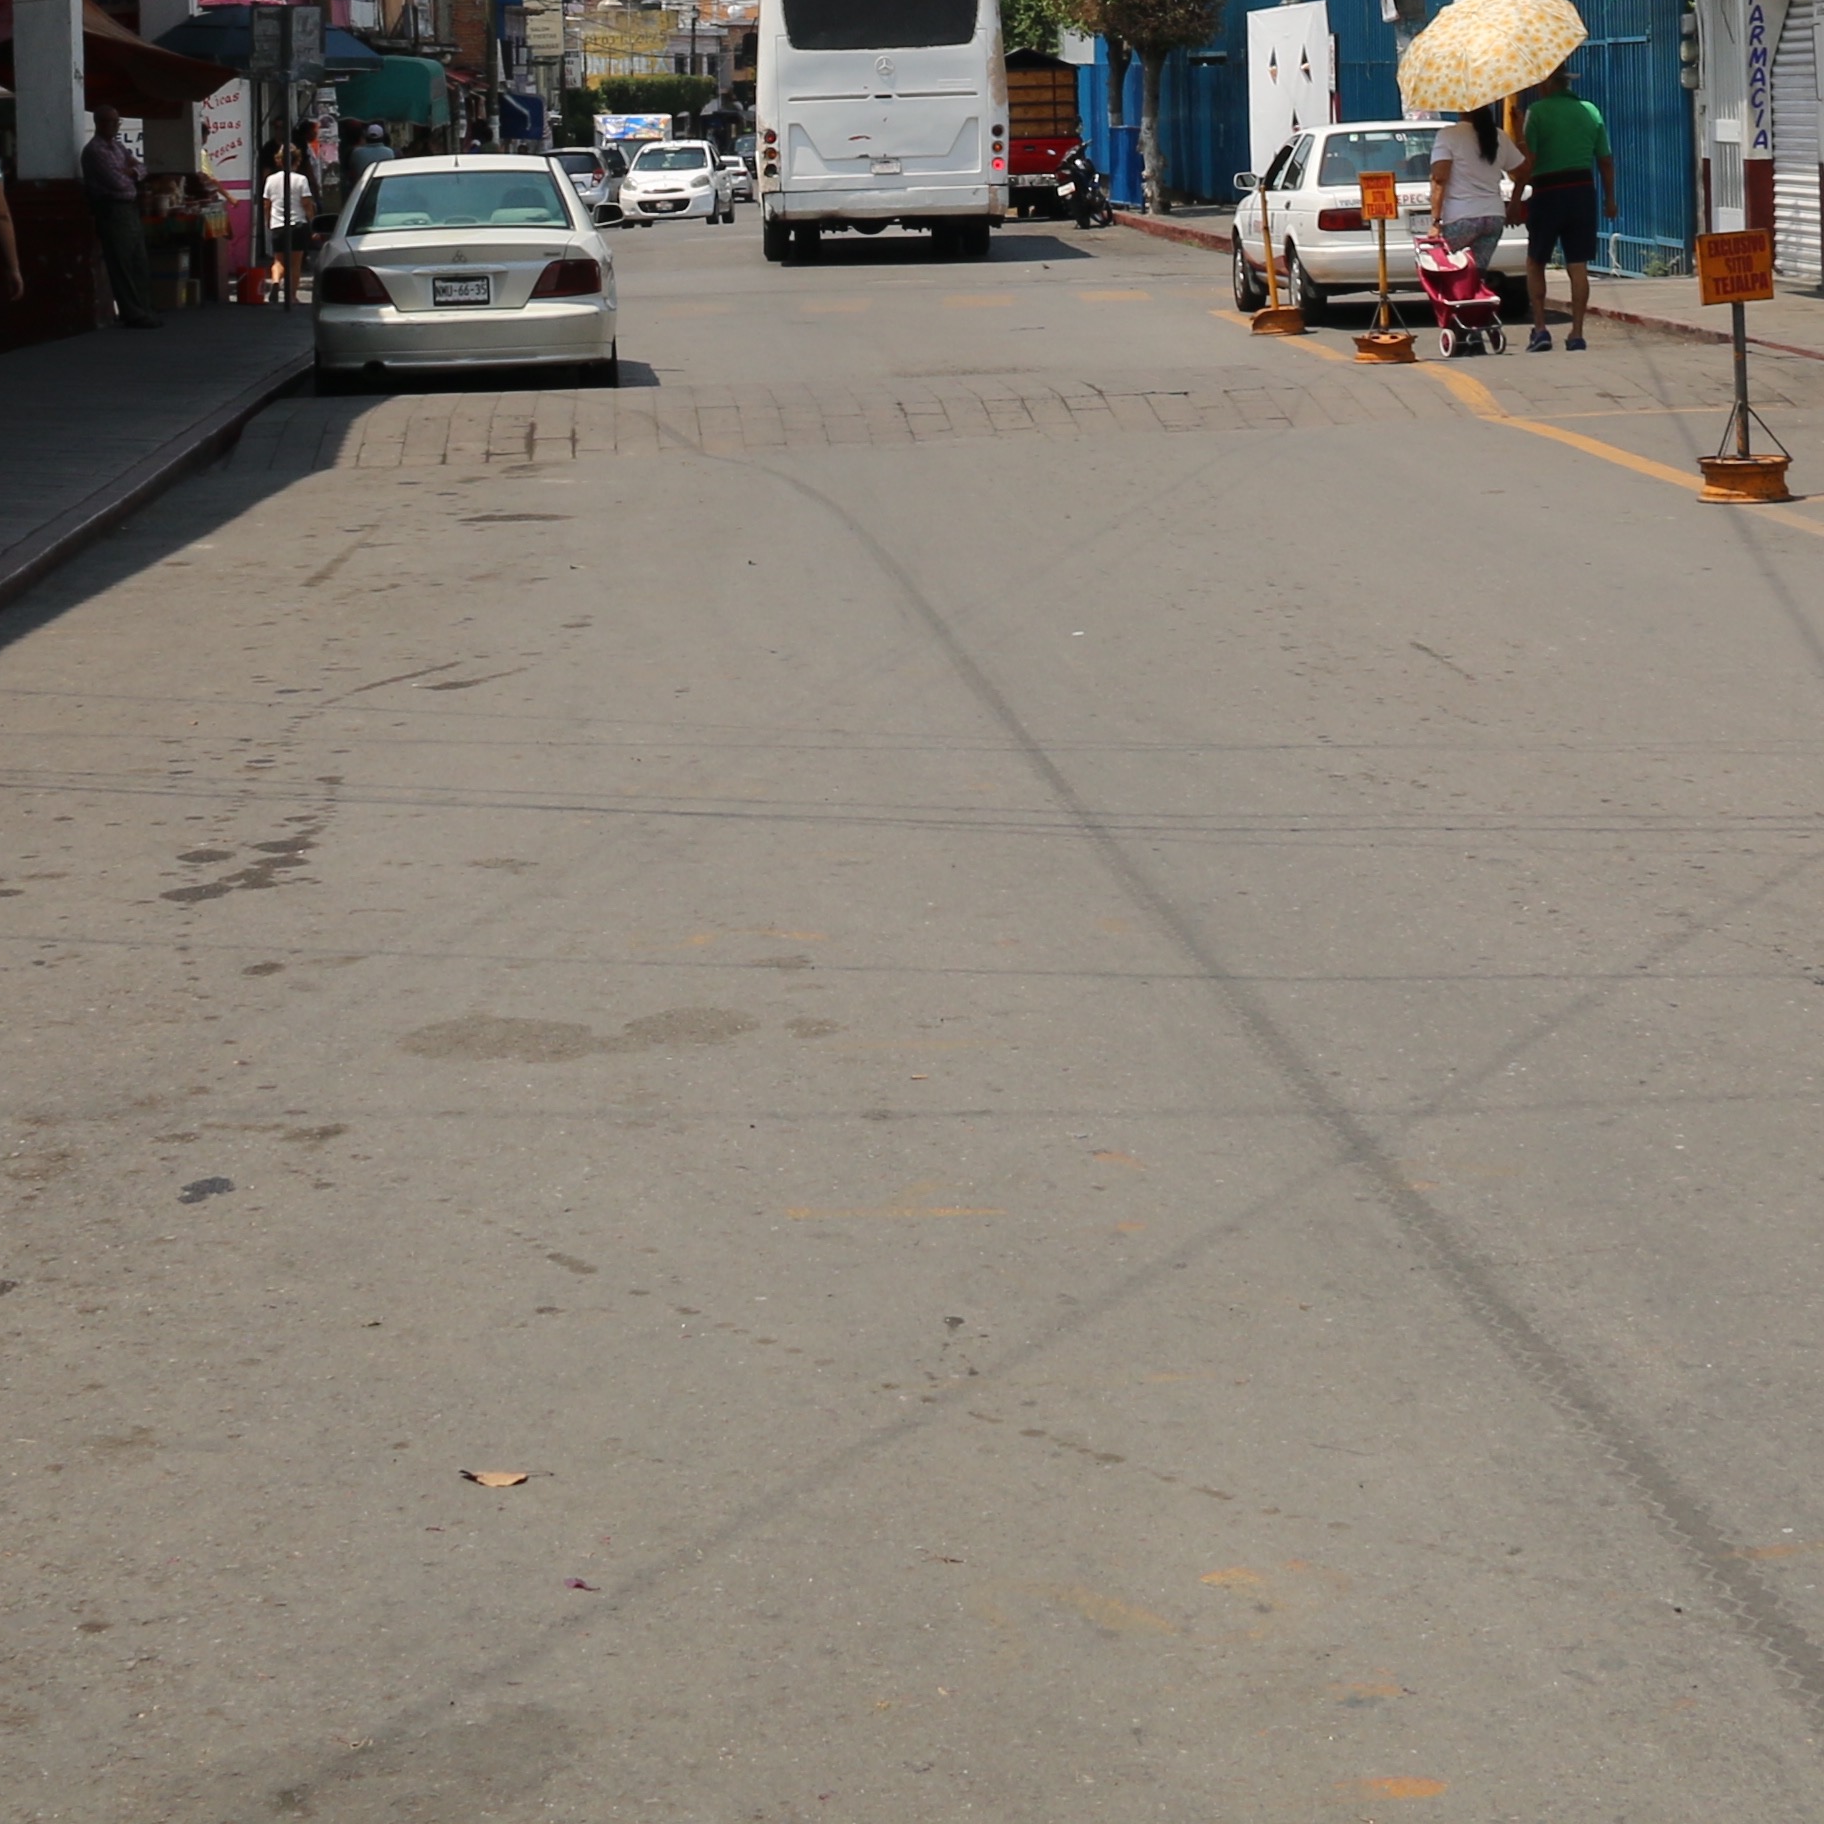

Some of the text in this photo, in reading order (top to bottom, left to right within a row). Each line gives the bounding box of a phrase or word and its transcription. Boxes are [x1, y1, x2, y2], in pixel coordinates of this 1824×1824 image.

[1707, 234, 1766, 258] EXCLUSIVO
[1724, 255, 1754, 274] SITIO
[1712, 270, 1770, 295] TEJALPA
